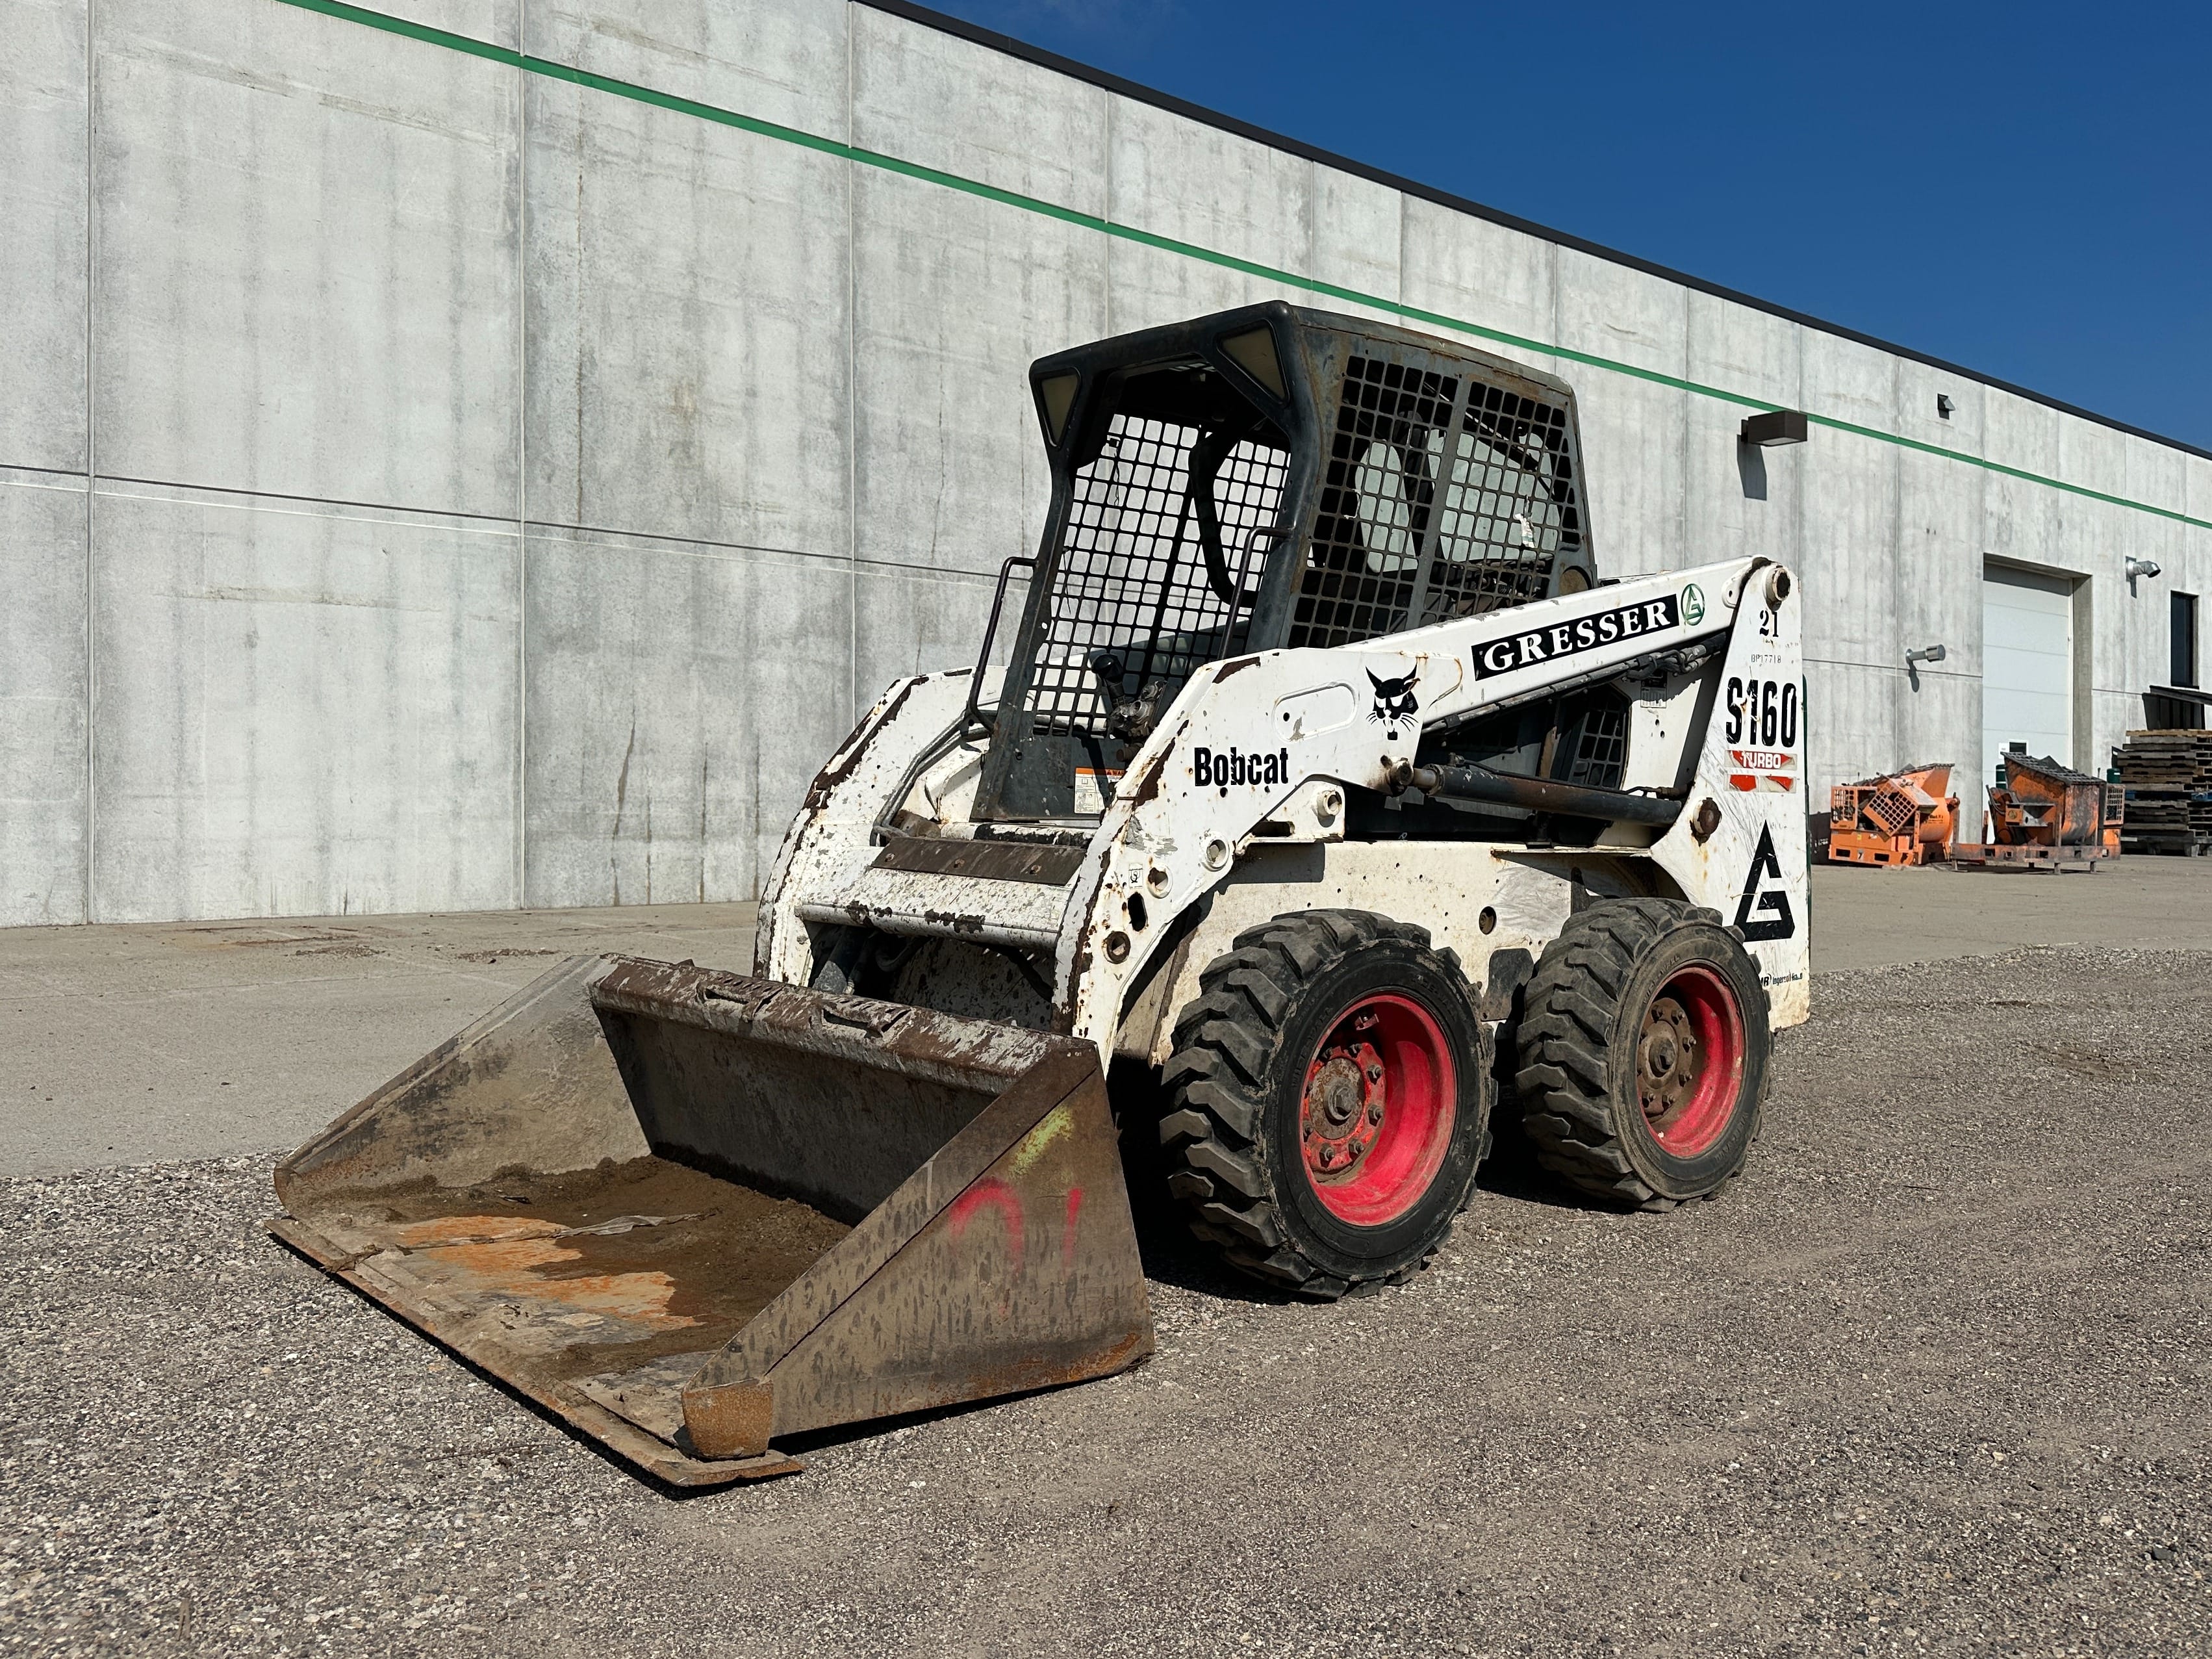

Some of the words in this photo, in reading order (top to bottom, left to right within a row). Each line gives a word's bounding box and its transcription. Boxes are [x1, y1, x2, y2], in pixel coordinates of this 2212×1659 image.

[1484, 602, 1670, 671] GRESSER
[1759, 610, 1779, 637] 21
[1725, 676, 1798, 748] S160
[1194, 747, 1289, 787] Bobcat
[1741, 752, 1781, 769] TURBO
